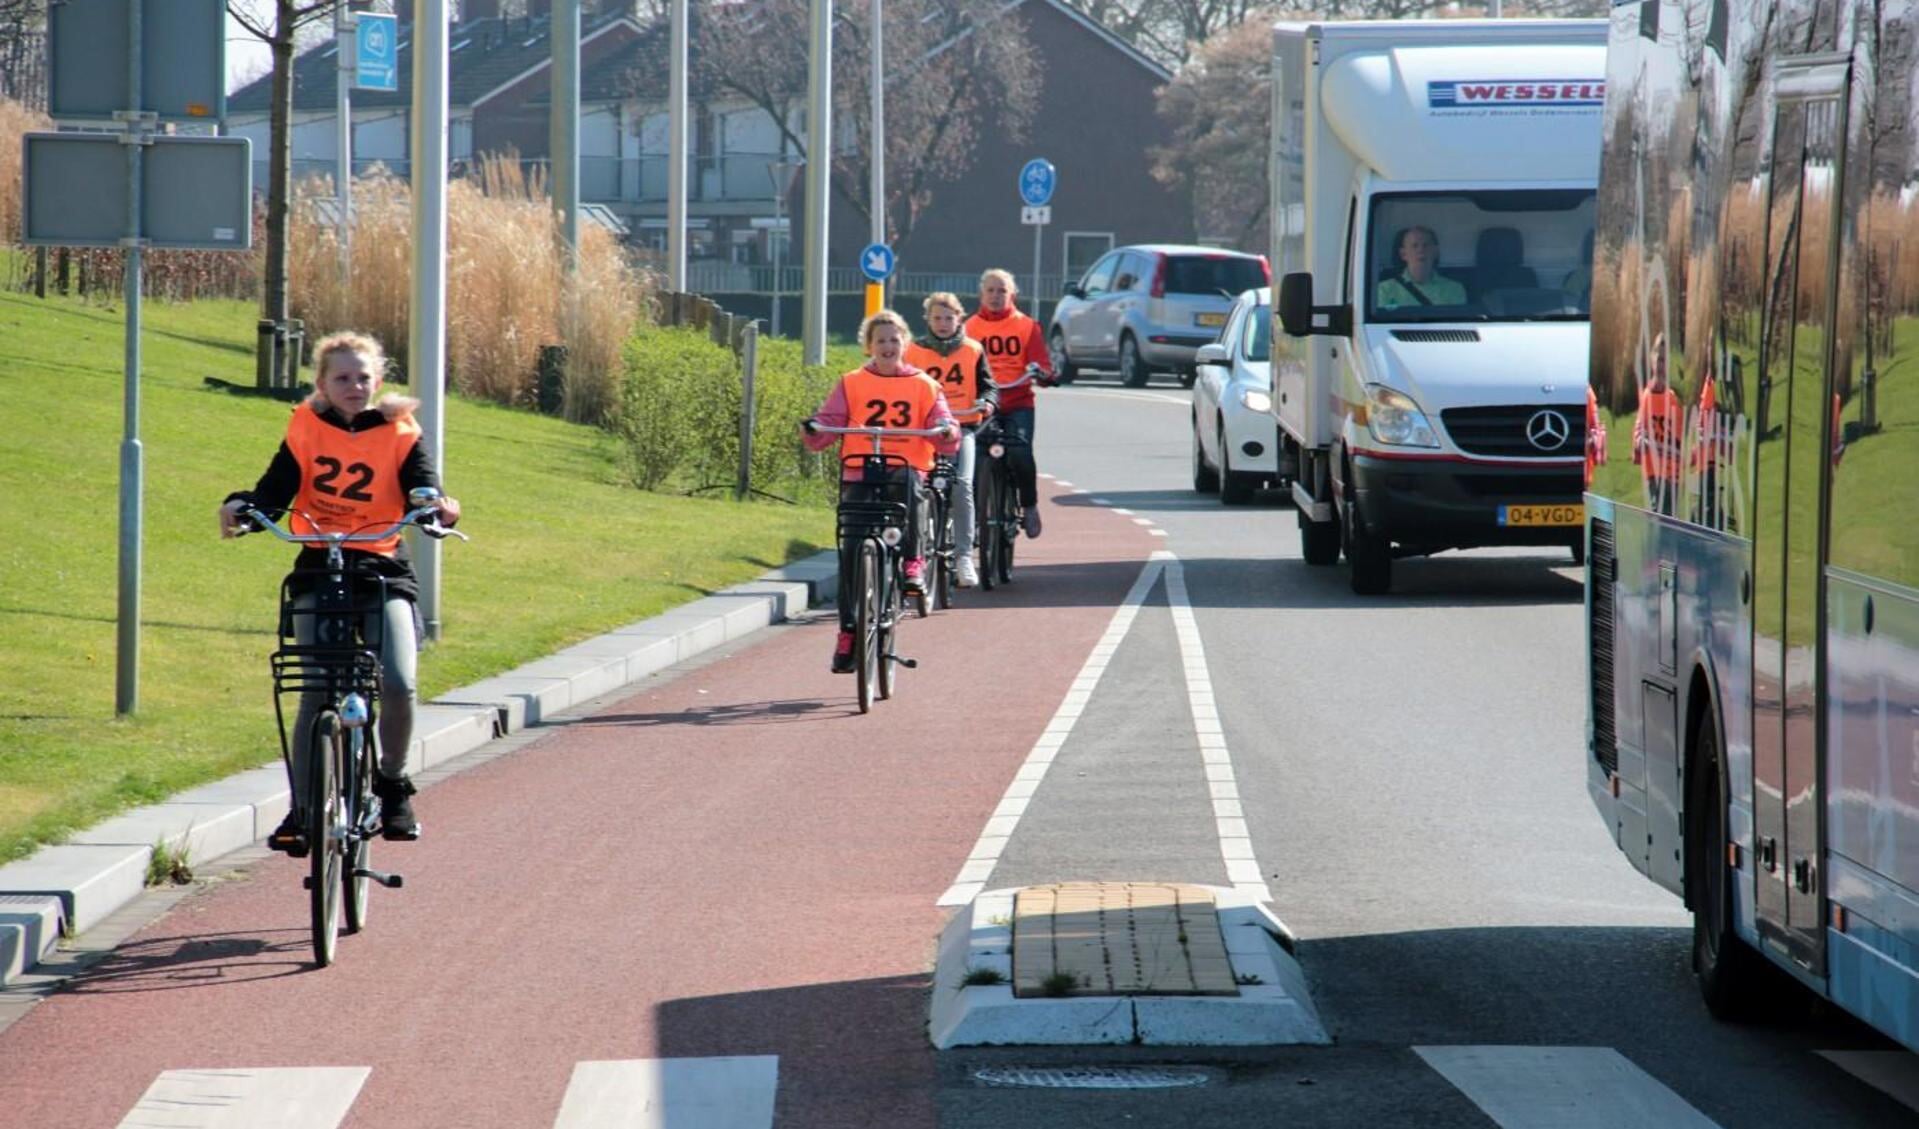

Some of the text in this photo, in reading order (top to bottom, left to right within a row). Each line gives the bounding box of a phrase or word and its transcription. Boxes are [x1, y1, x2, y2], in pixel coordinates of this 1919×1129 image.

[981, 336, 1021, 356] 100
[926, 362, 964, 386] 24
[864, 399, 912, 428] 23
[313, 455, 375, 503] 22
